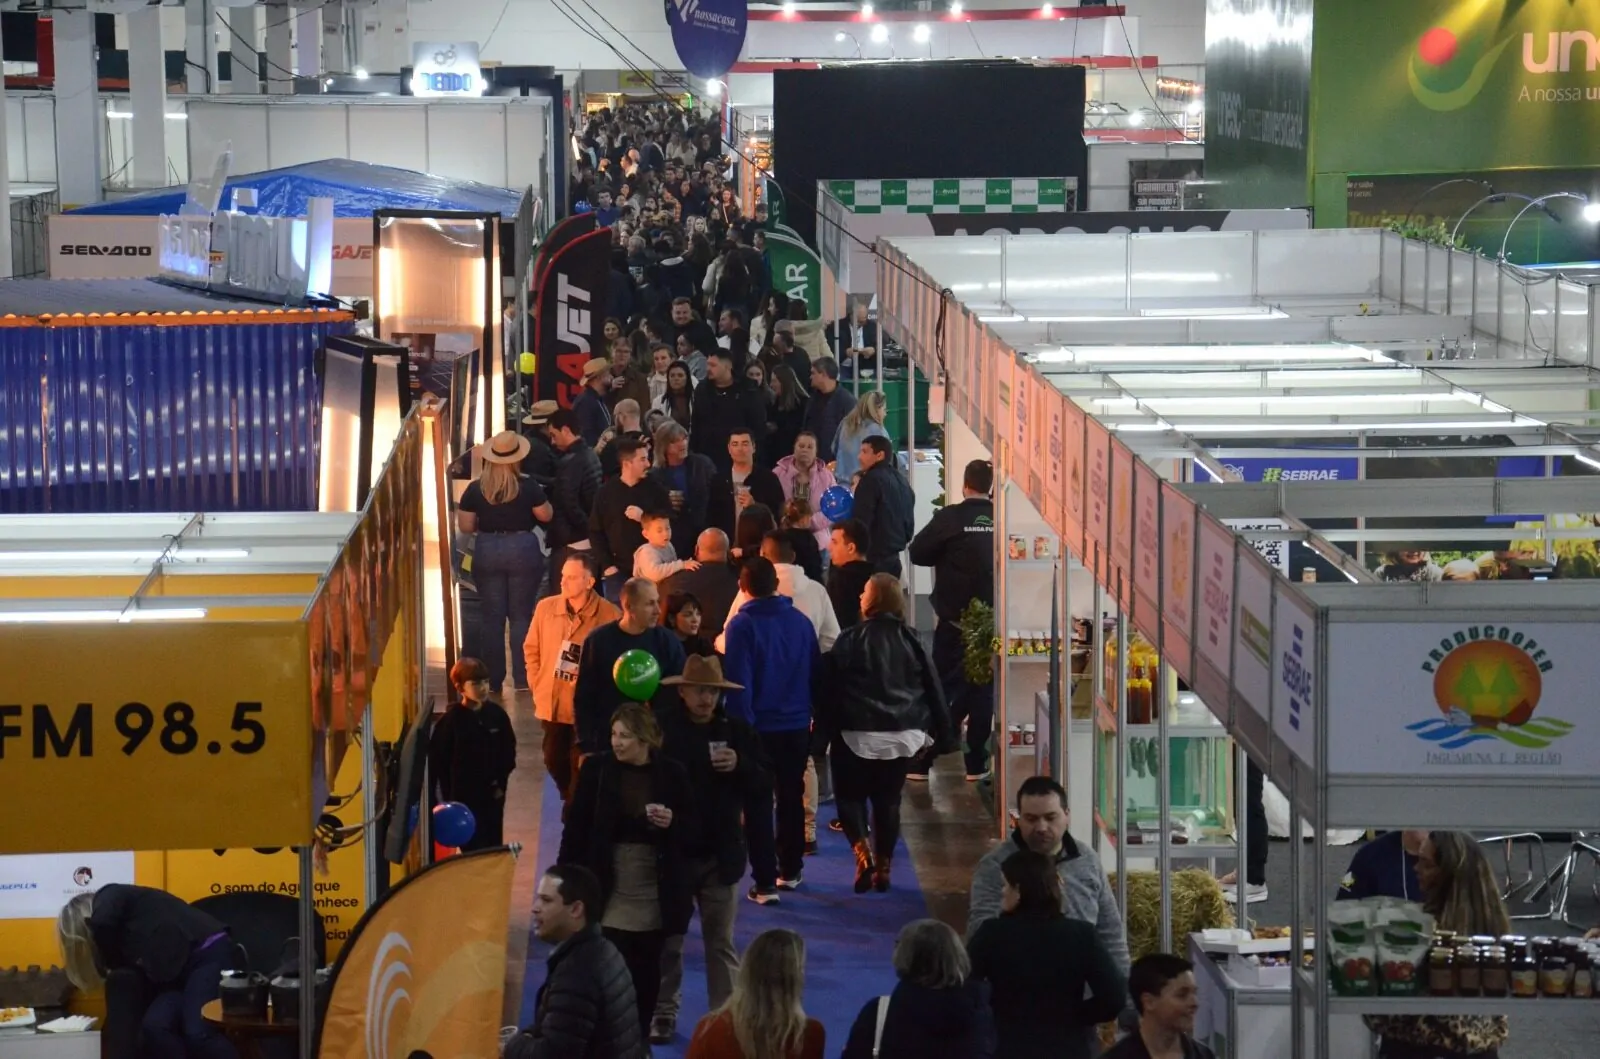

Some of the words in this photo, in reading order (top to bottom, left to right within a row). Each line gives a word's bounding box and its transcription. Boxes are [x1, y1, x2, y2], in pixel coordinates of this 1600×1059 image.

[694, 9, 736, 27] nossacasa
[1523, 30, 1600, 74] un
[1518, 84, 1531, 102] A
[1535, 87, 1581, 102] nossa
[1586, 87, 1600, 100] u
[1421, 625, 1553, 674] PRODUCOOPER
[1282, 651, 1312, 707] SEBRAE
[114, 701, 267, 757] 98.5
[210, 882, 222, 894] O
[225, 884, 254, 894] som
[258, 881, 275, 894] do
[314, 882, 340, 896] que
[313, 896, 358, 908] onhece
